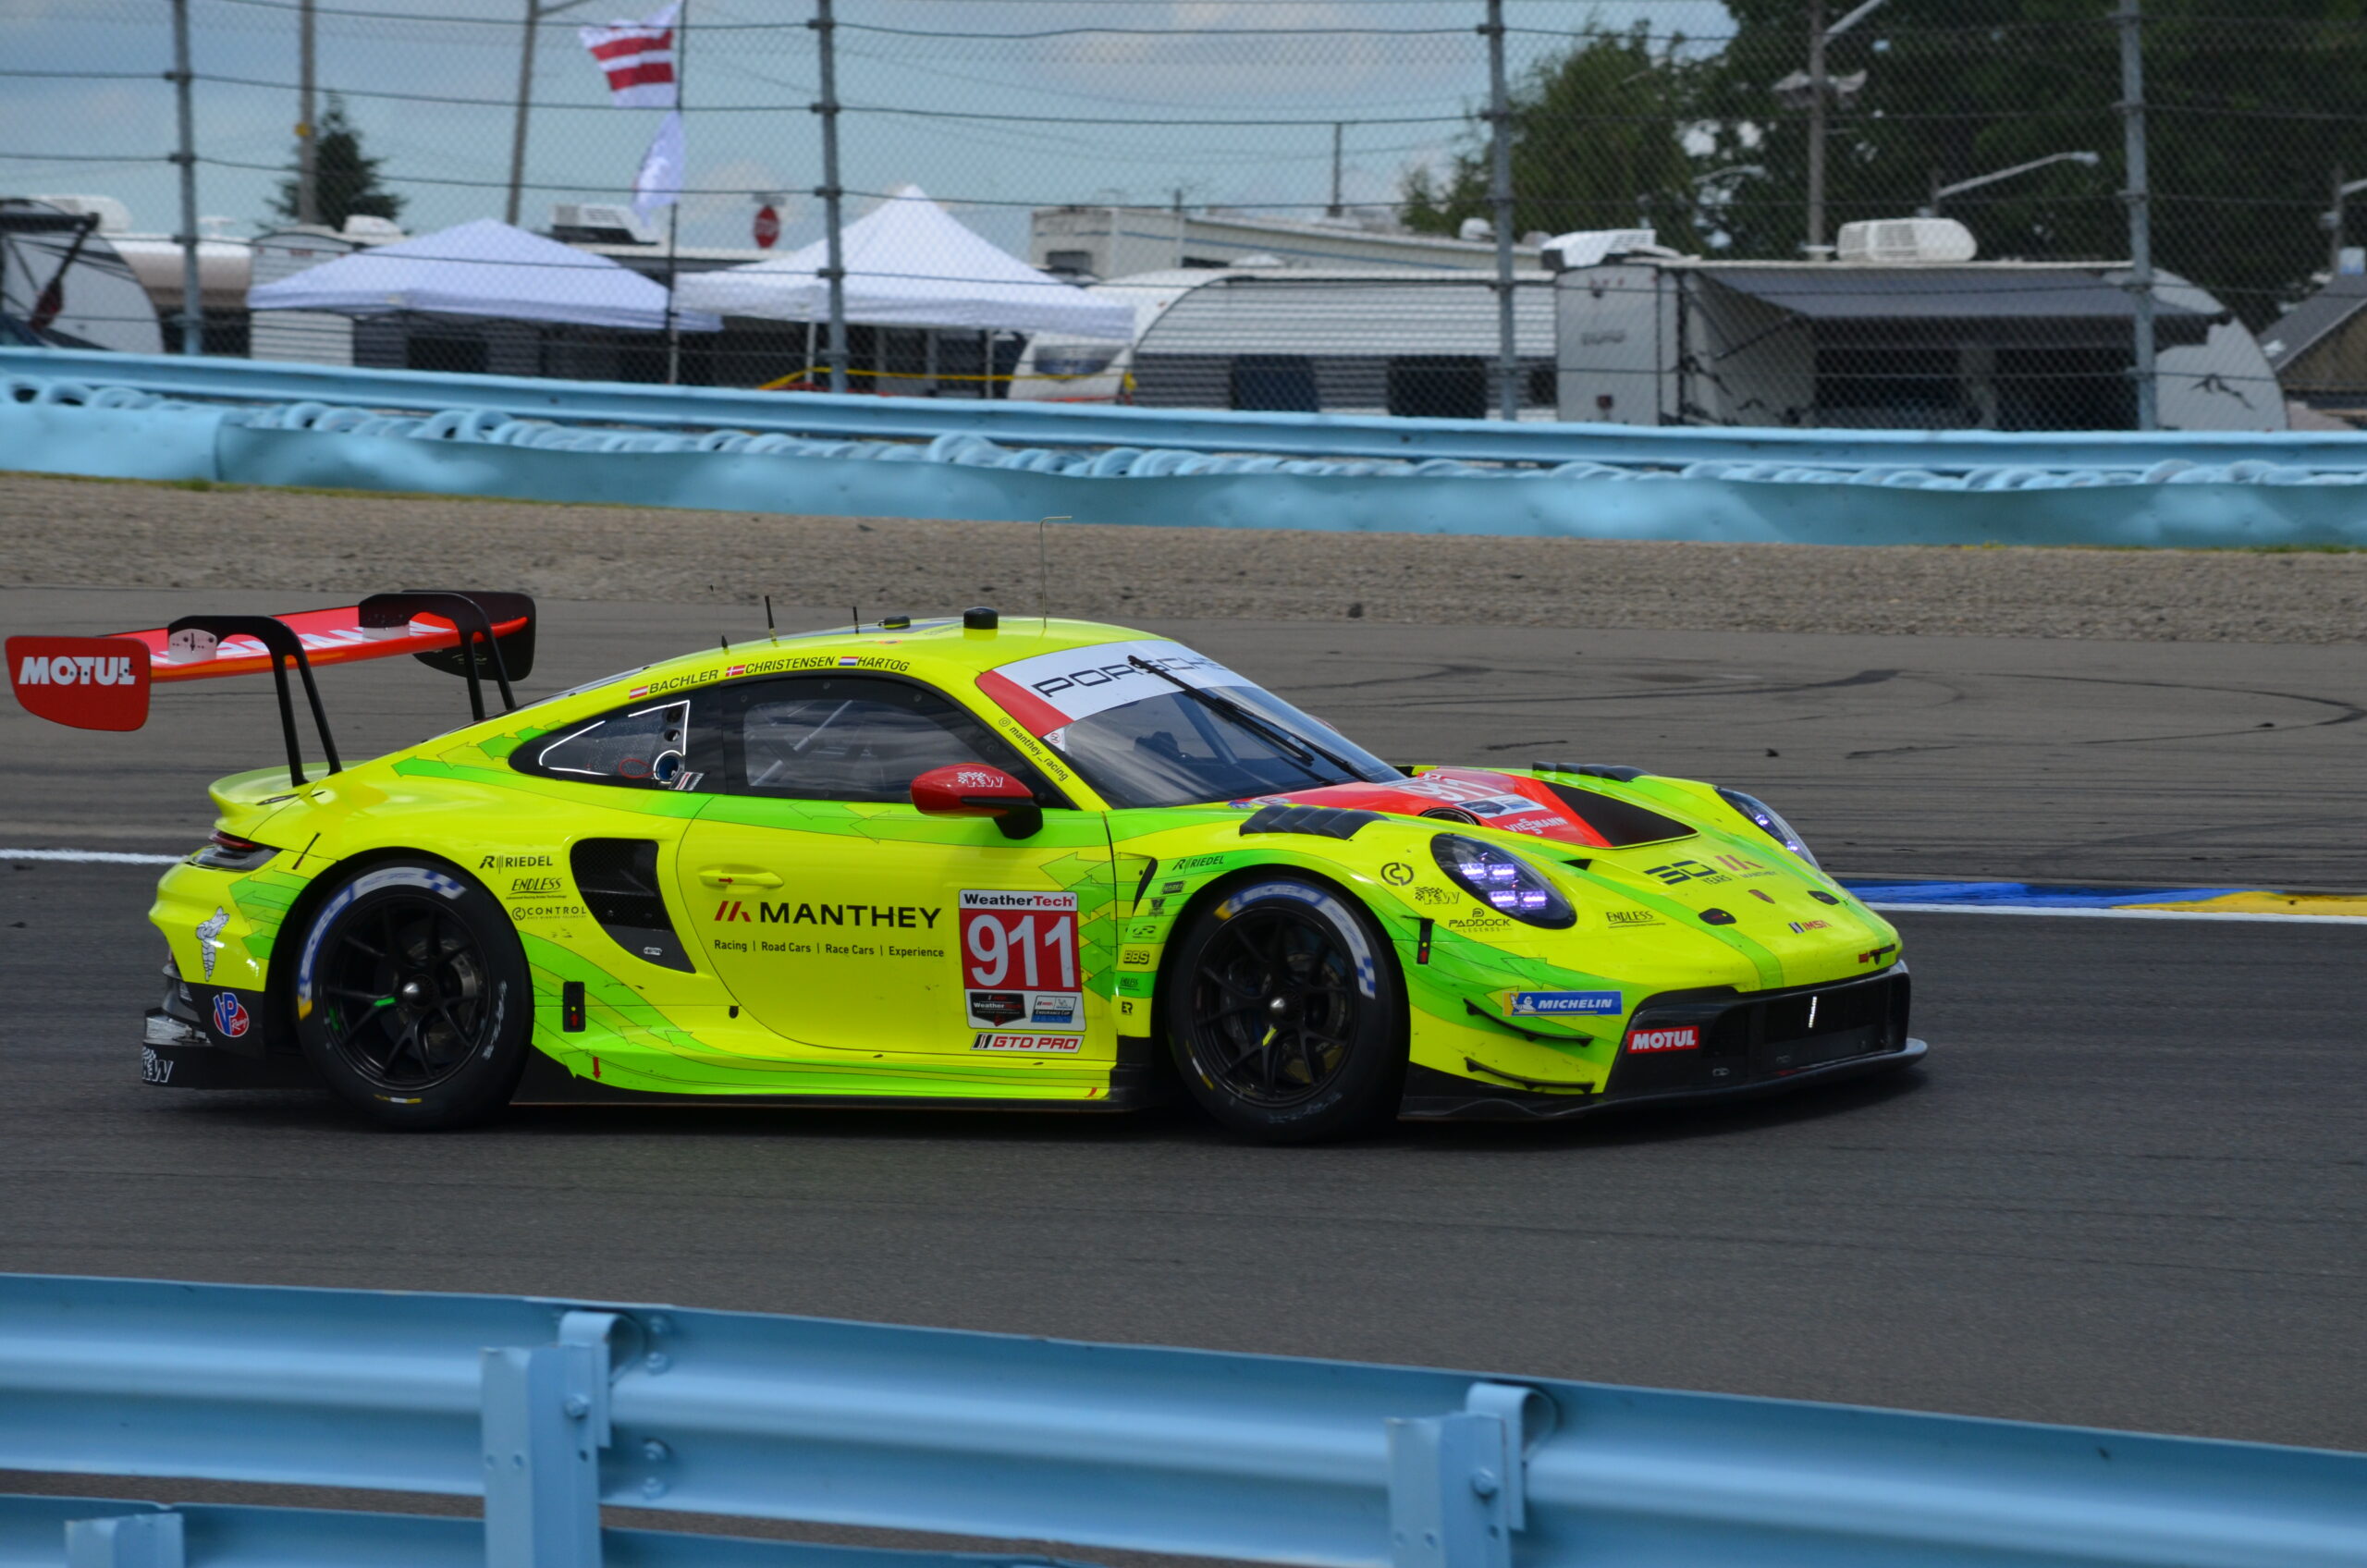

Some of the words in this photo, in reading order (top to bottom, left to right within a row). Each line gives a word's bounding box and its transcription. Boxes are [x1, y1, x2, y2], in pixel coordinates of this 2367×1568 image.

[18, 655, 137, 686] MOTUL
[649, 668, 718, 694] BACHLER
[745, 655, 835, 674] CHRISTENSEN
[857, 656, 910, 672] HARTOG
[1009, 726, 1070, 781] manthey_racing
[505, 855, 554, 868] RIEDEL
[1190, 855, 1224, 868] RIEDEL
[511, 876, 563, 891] ENDLESS
[964, 893, 1074, 907] WeatherTech
[527, 906, 587, 915] CONTROL
[759, 901, 942, 929] MANTHEY
[1607, 910, 1654, 923] ENDLESS
[1449, 918, 1511, 927] PADDOCK
[714, 939, 747, 952] Racing
[761, 941, 786, 952] Road
[789, 942, 812, 953] Cars
[826, 943, 849, 954] Race
[852, 944, 875, 955] Cars
[889, 946, 945, 958] Experience
[967, 913, 1074, 987] 911
[1123, 949, 1150, 965] BBS
[1538, 998, 1613, 1011] MICHELIN
[992, 1035, 1034, 1048] GTD
[1036, 1037, 1079, 1049] PRO
[1631, 1029, 1696, 1050] MOTUL
